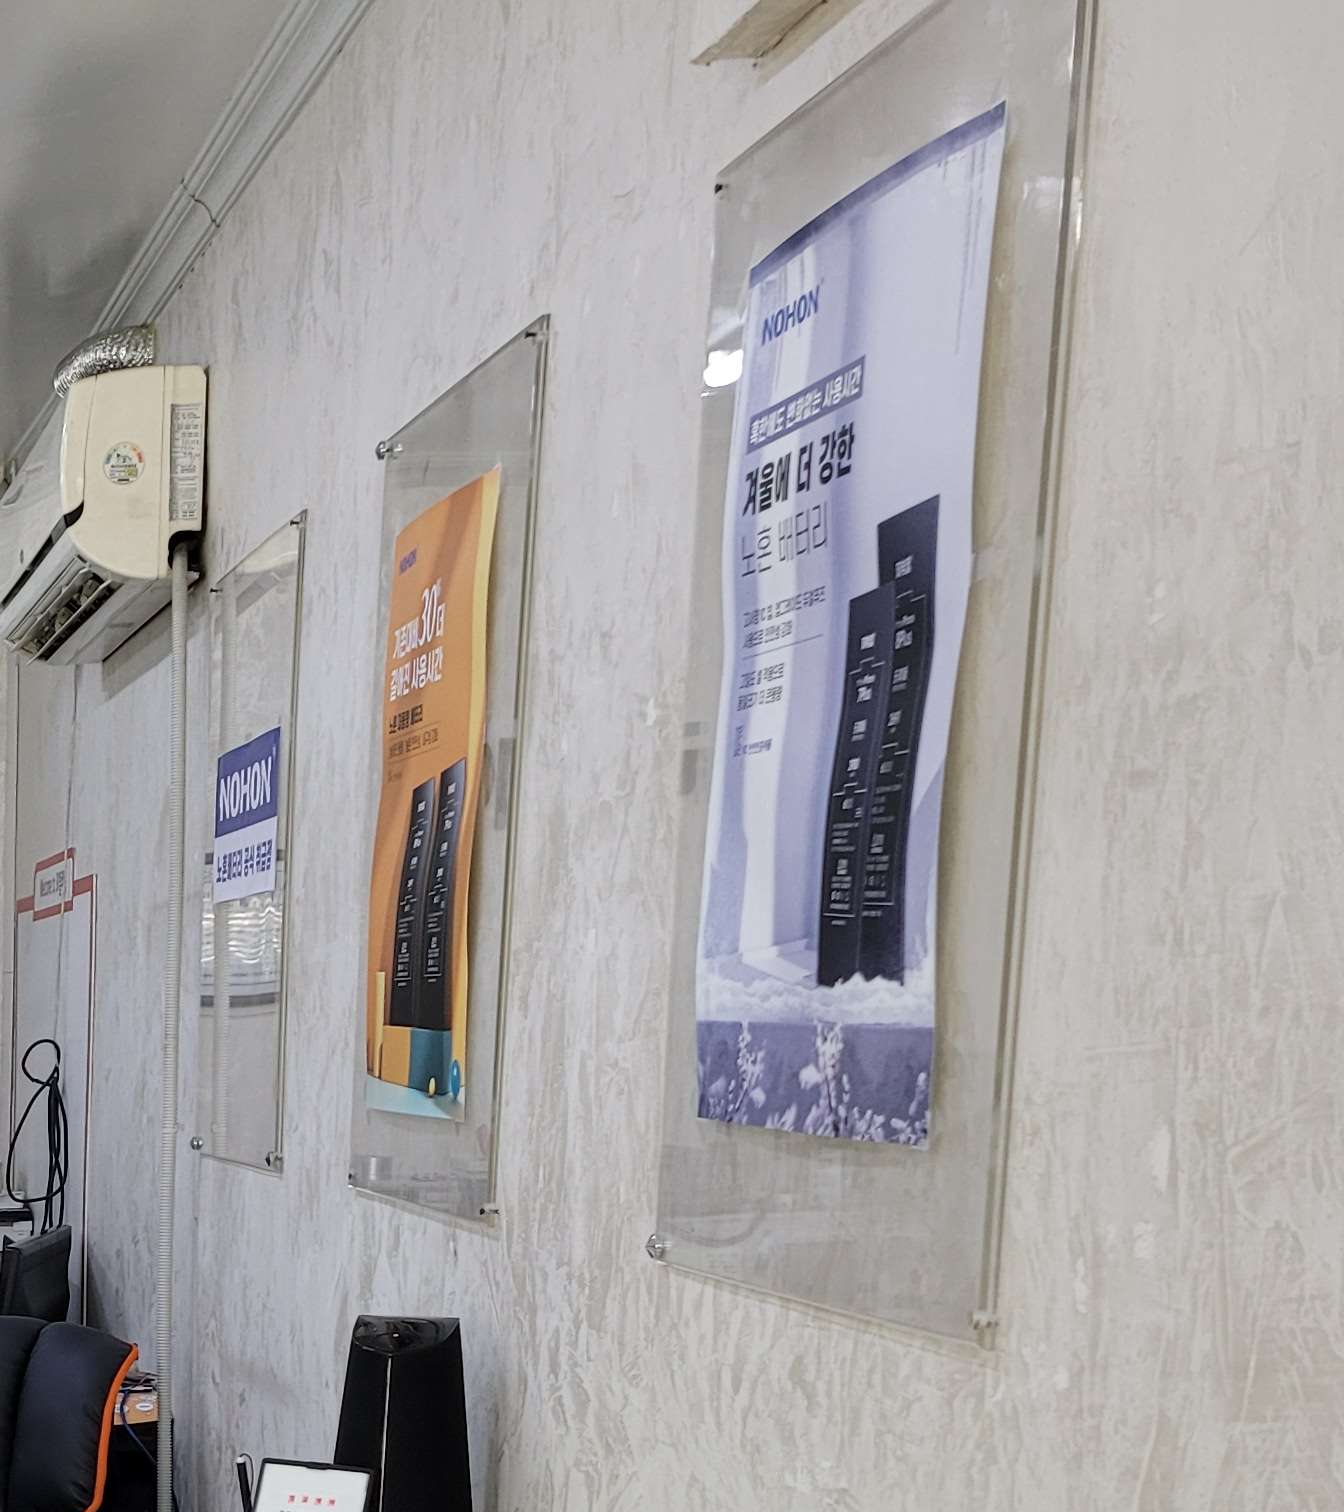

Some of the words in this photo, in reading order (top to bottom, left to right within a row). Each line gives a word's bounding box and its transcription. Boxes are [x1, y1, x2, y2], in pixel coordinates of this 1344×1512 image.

[761, 284, 820, 346] NOHON
[822, 364, 862, 408] 사용시간
[742, 452, 792, 517] 겨울에
[796, 441, 813, 494] 더
[819, 421, 854, 486] 강한
[778, 501, 828, 563] 배터리
[411, 646, 444, 690] 사용시간
[219, 755, 272, 822] NOHON
